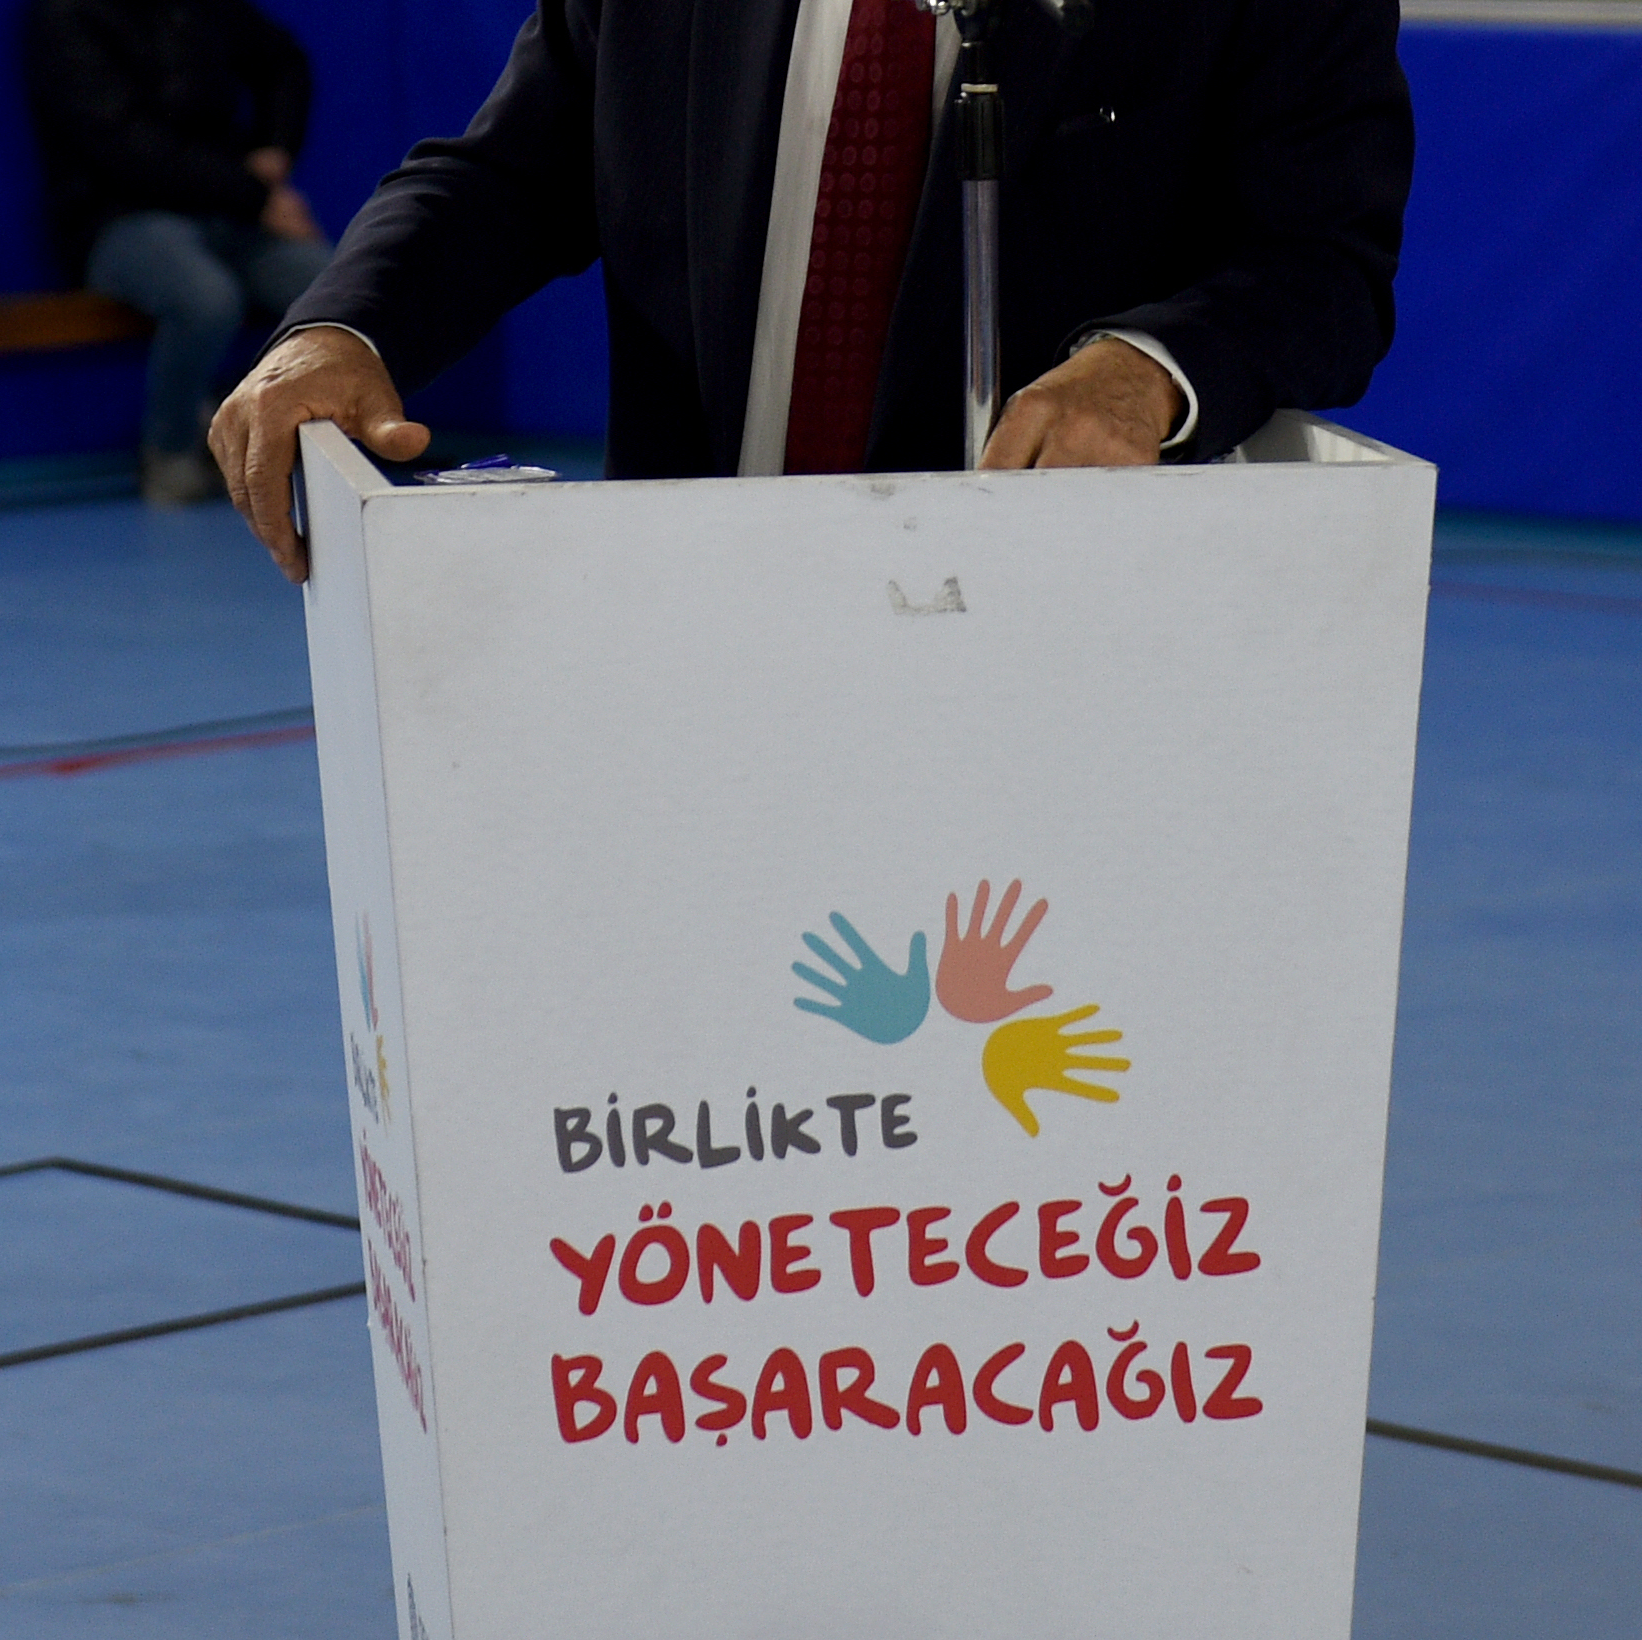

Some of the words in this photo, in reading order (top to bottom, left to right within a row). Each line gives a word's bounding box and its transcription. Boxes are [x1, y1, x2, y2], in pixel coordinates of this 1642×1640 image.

[553, 1086, 918, 1173] BİRLİKTE
[550, 1174, 1261, 1316] YÖNETECEĞİZ
[552, 1321, 1264, 1447] BAŞARACAĞIZ
